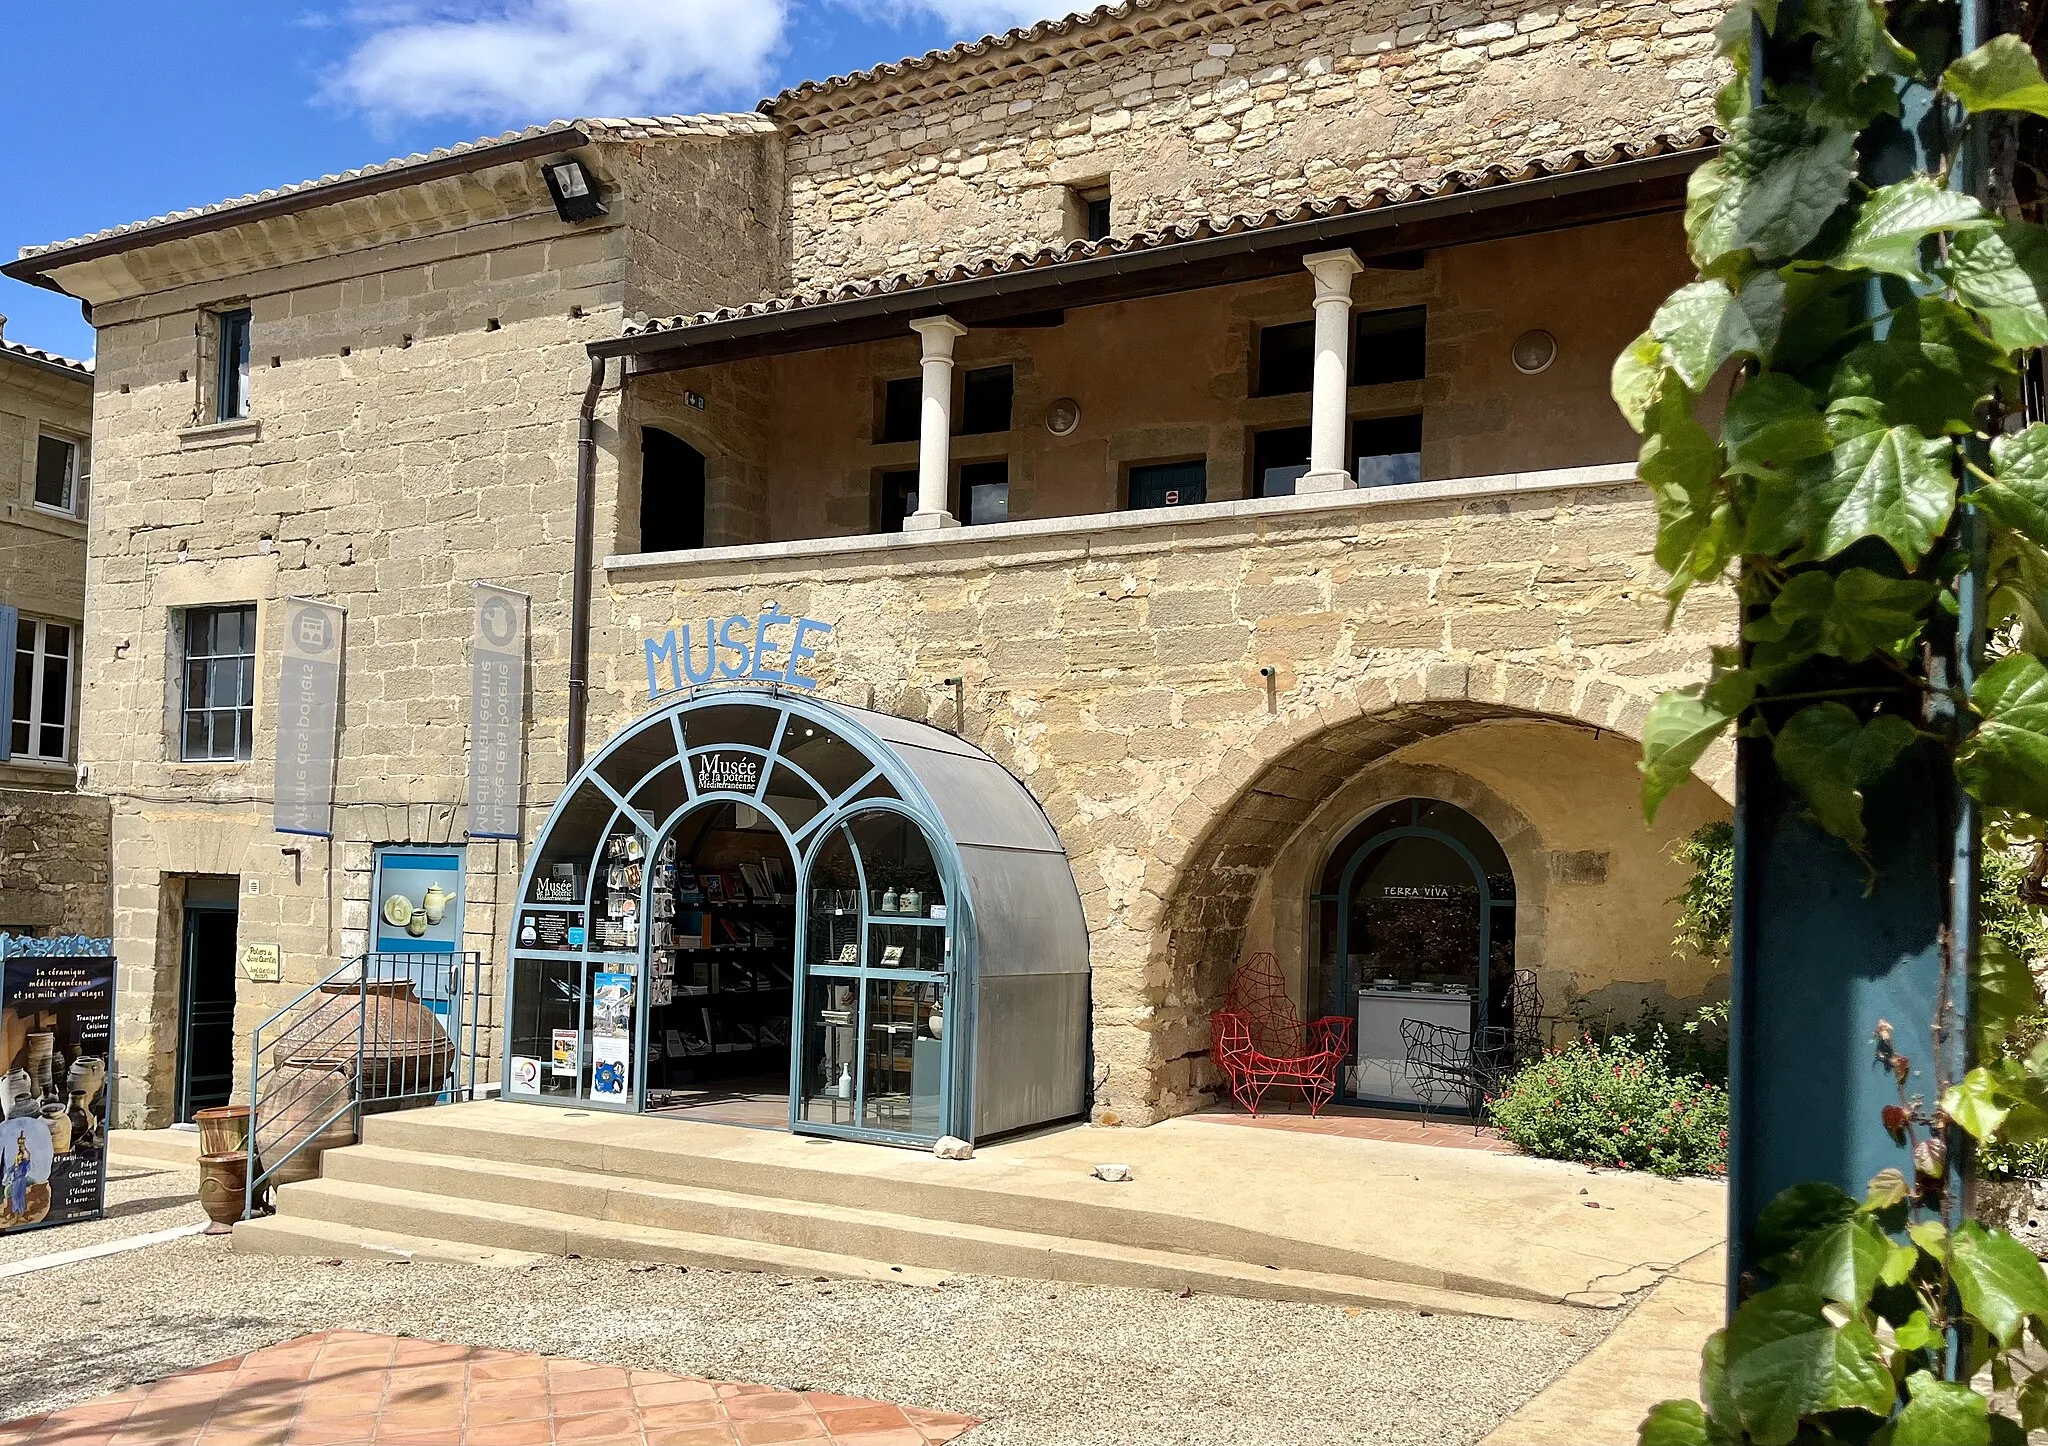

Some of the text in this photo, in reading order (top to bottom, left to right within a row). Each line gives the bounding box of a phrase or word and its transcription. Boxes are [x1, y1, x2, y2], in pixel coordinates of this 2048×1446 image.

[644, 604, 832, 701] MUSÉE
[699, 754, 757, 775] Musée
[699, 769, 756, 784] de la poterie
[536, 877, 573, 892] Musée
[1383, 886, 1420, 896] TERRA
[36, 967, 86, 978] La céramique
[28, 978, 92, 988] méditerranéenne
[13, 990, 22, 999] et
[24, 991, 35, 999] ses
[37, 990, 57, 999] mille
[59, 990, 67, 998] et
[81, 990, 104, 999] usages
[76, 1013, 109, 1022] Transporter
[81, 1031, 108, 1039] Conserver
[68, 1170, 97, 1178] Construire
[65, 1197, 72, 1206] Se
